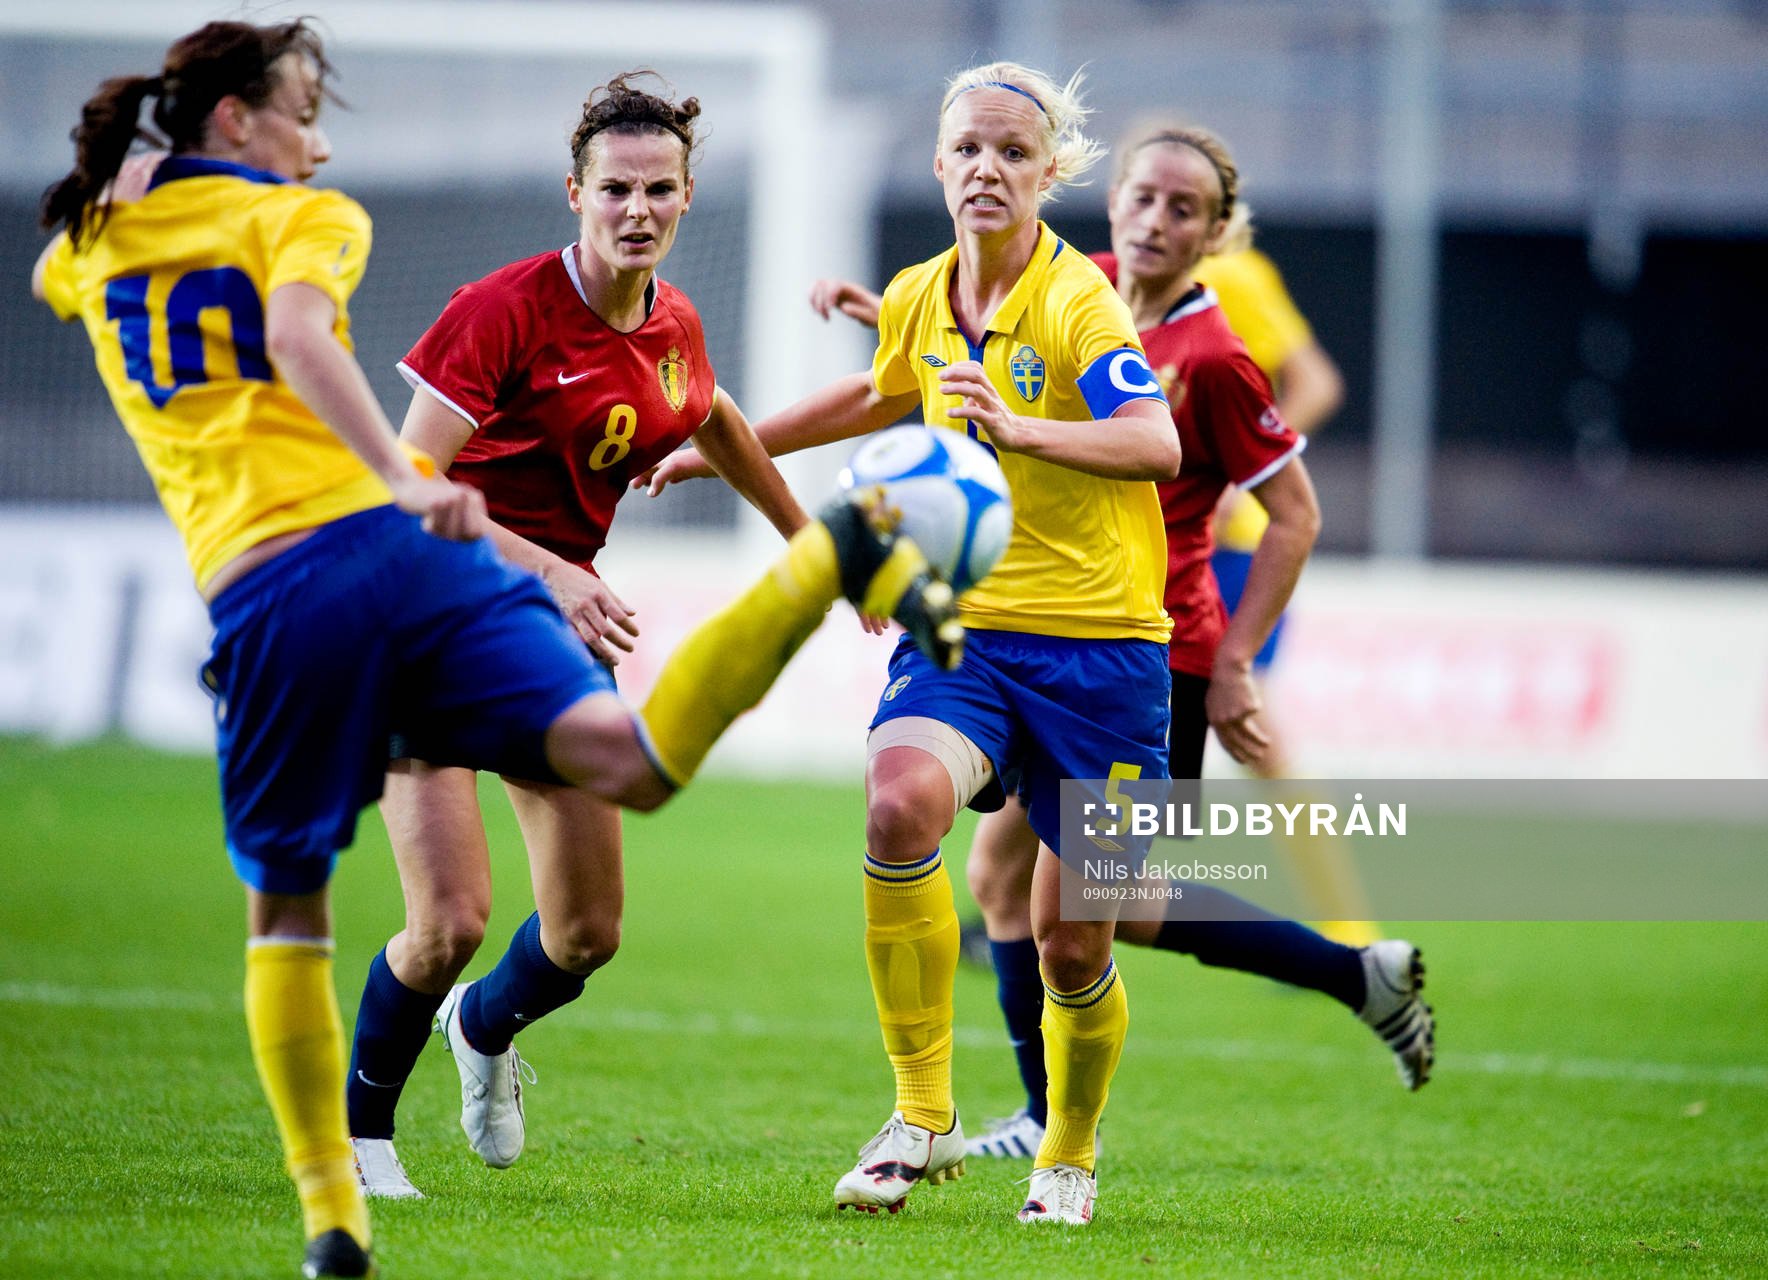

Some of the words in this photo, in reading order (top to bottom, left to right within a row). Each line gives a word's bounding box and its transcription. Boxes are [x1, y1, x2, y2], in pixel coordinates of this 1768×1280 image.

[105, 265, 274, 410] 10
[1108, 352, 1159, 394] C
[588, 404, 637, 471] 8
[1095, 761, 1143, 836] 5
